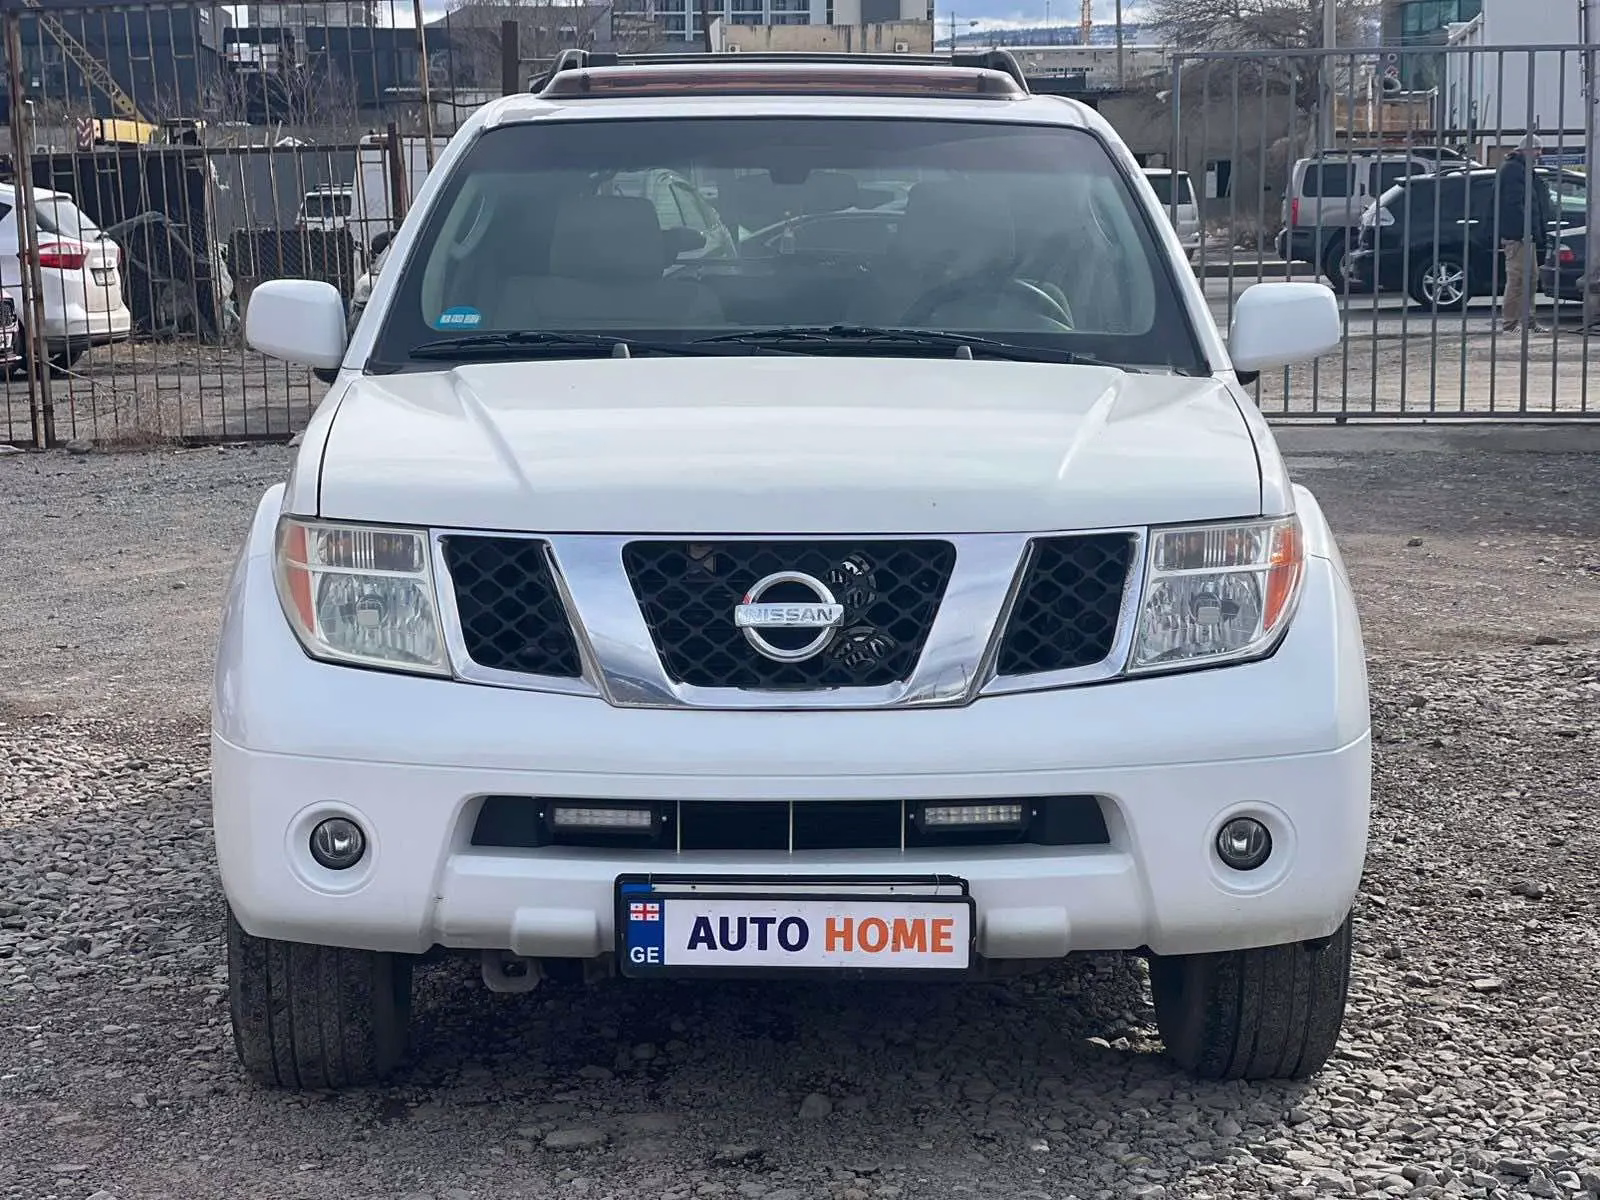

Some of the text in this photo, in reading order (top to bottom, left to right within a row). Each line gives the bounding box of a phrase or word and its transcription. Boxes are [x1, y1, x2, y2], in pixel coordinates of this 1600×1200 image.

[744, 607, 833, 622] NISSAN
[687, 916, 954, 953] AUTO HOME
[629, 947, 660, 964] GE
